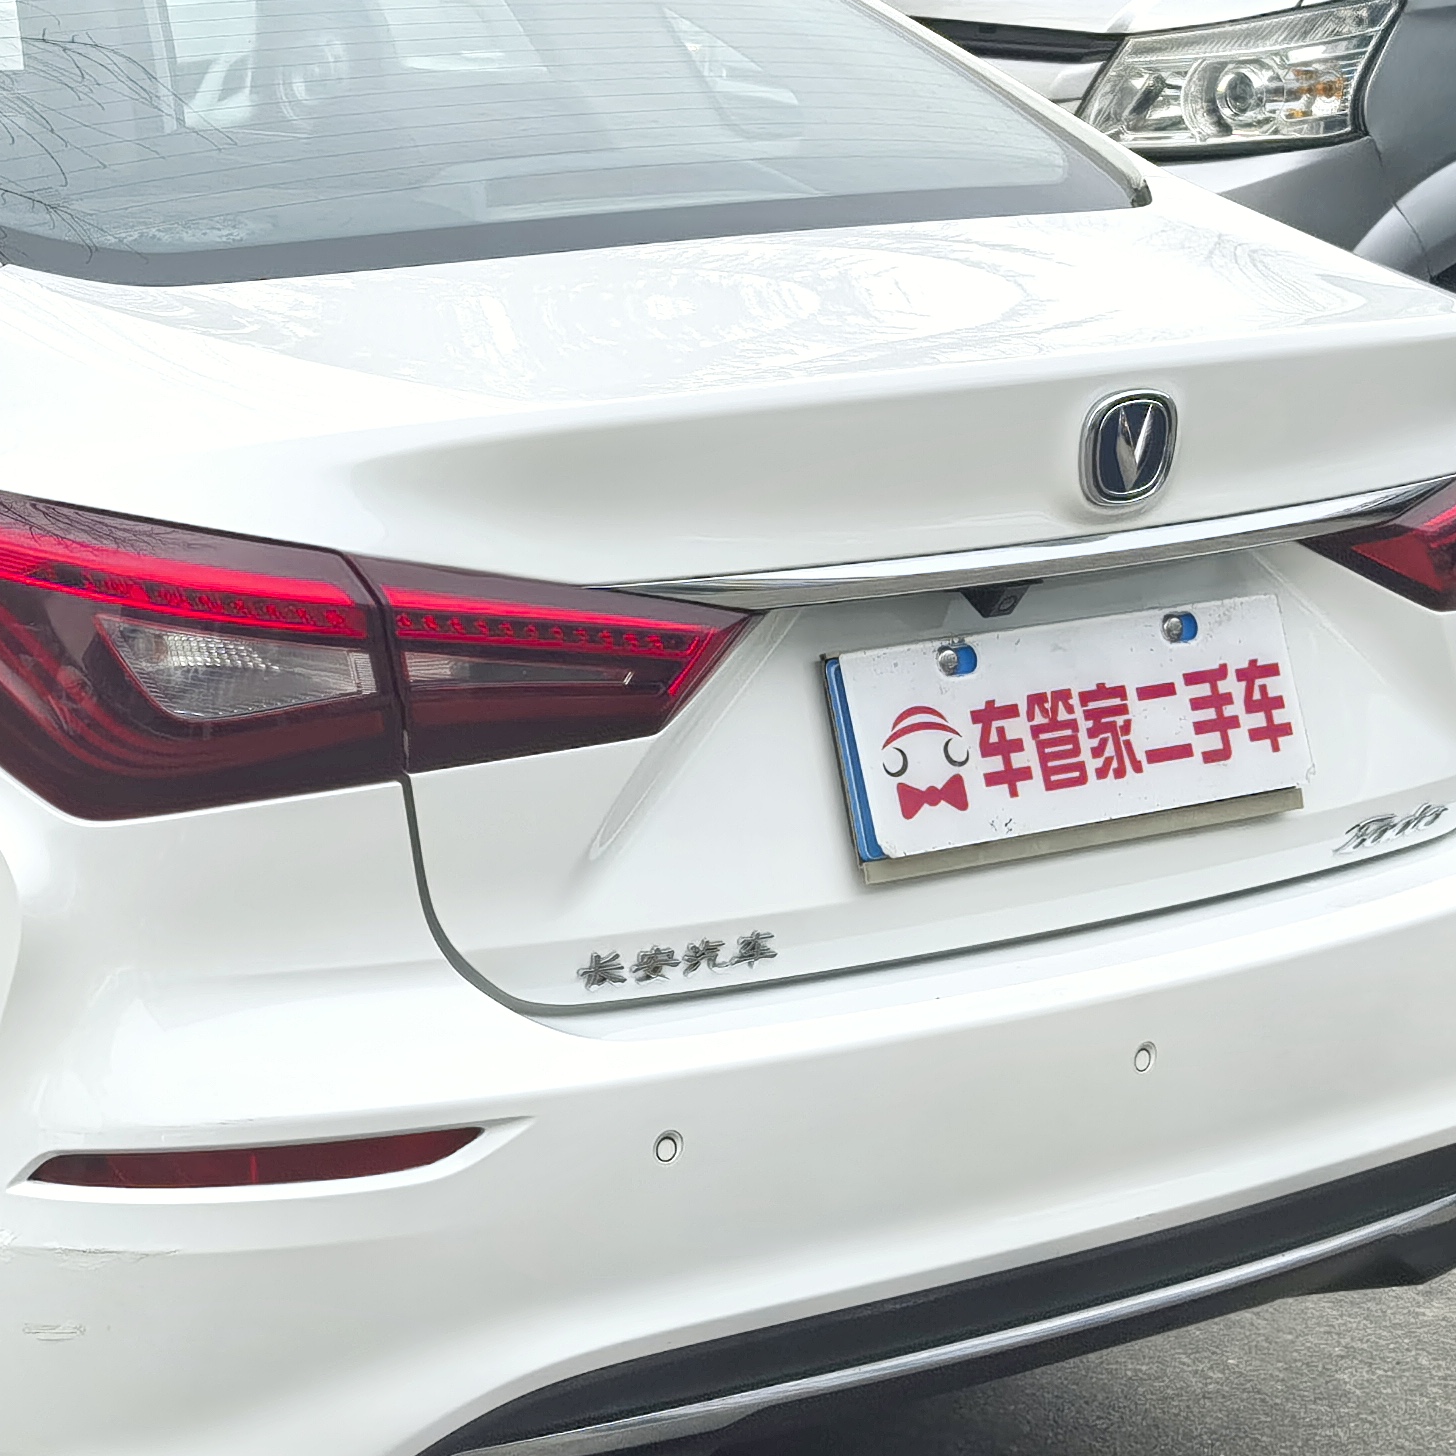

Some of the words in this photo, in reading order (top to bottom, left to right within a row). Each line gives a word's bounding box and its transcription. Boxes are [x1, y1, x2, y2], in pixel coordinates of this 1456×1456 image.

[969, 657, 1294, 800] 车管家二手车
[577, 929, 779, 992] 长安汽车
